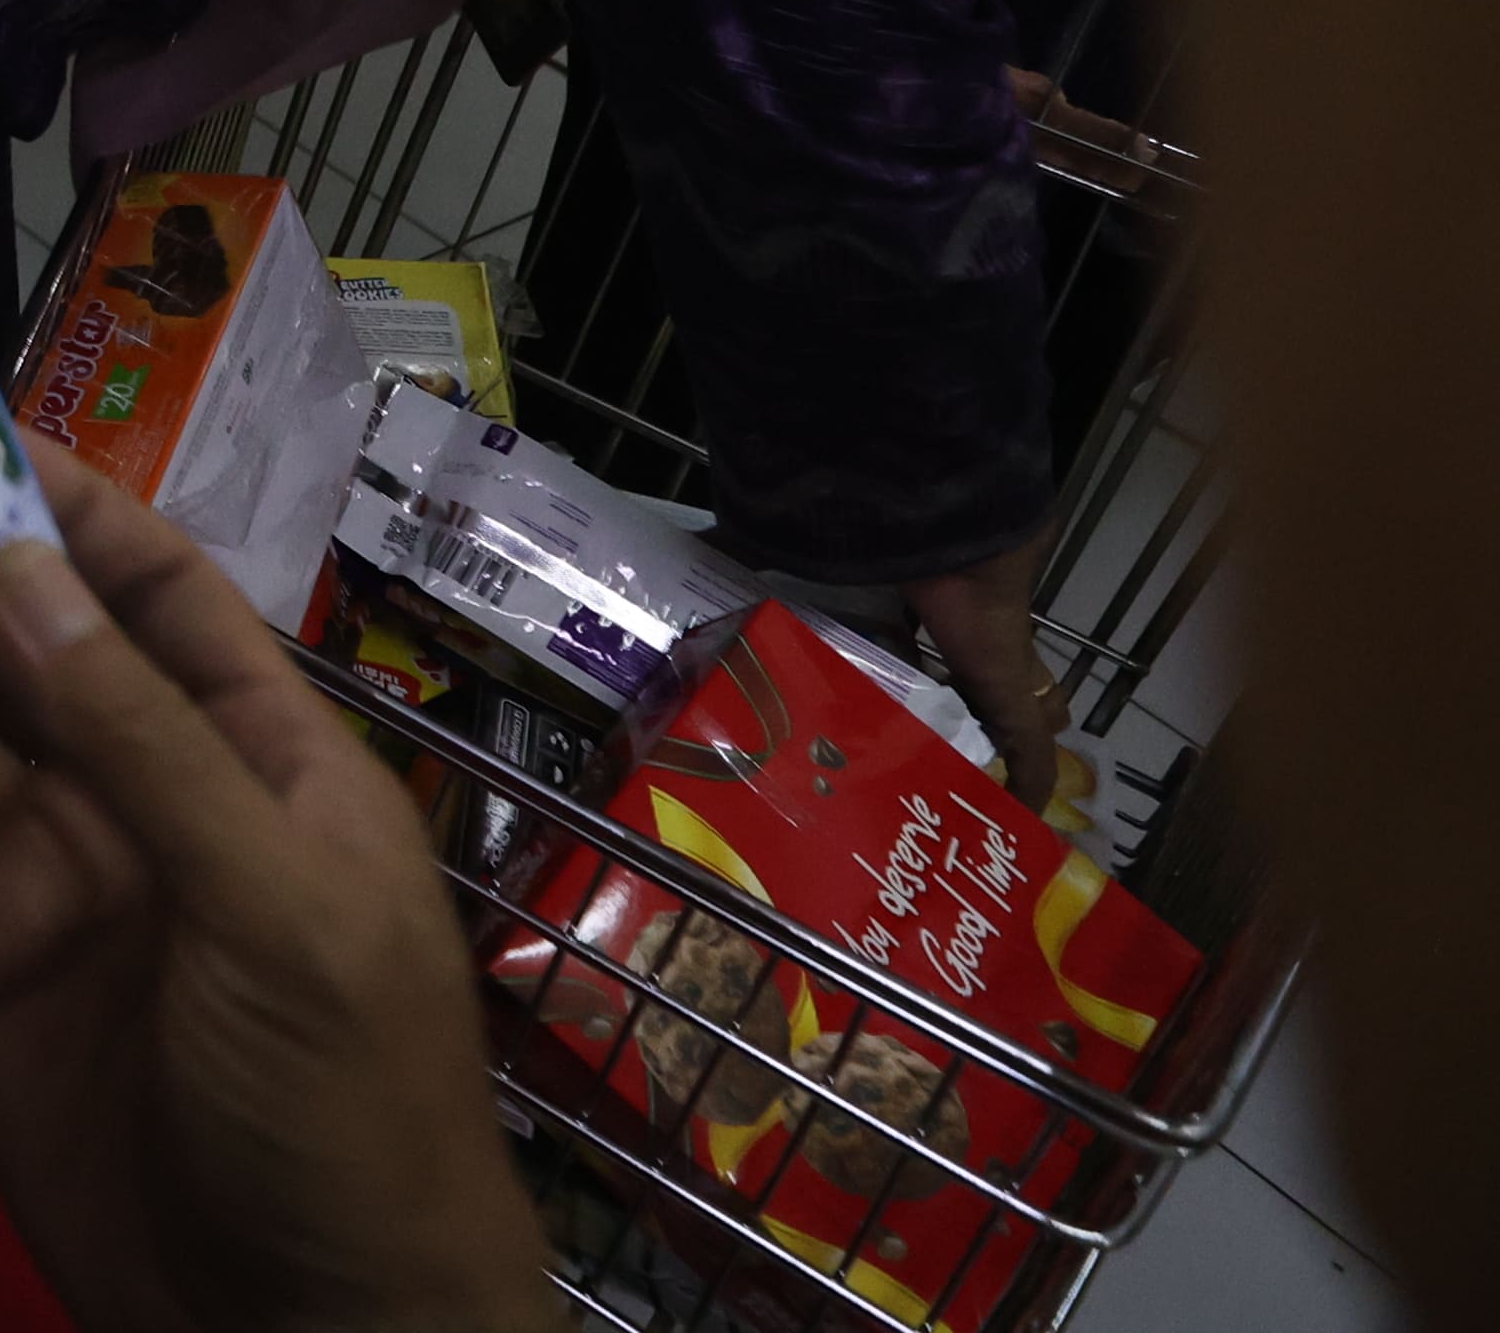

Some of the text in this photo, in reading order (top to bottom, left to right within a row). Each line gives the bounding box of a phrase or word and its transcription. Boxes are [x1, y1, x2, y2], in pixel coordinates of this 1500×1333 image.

[339, 288, 404, 302] OOKIES
[30, 300, 120, 451] perstar
[851, 793, 942, 918] deserve
[919, 789, 1030, 999] Good Time!
